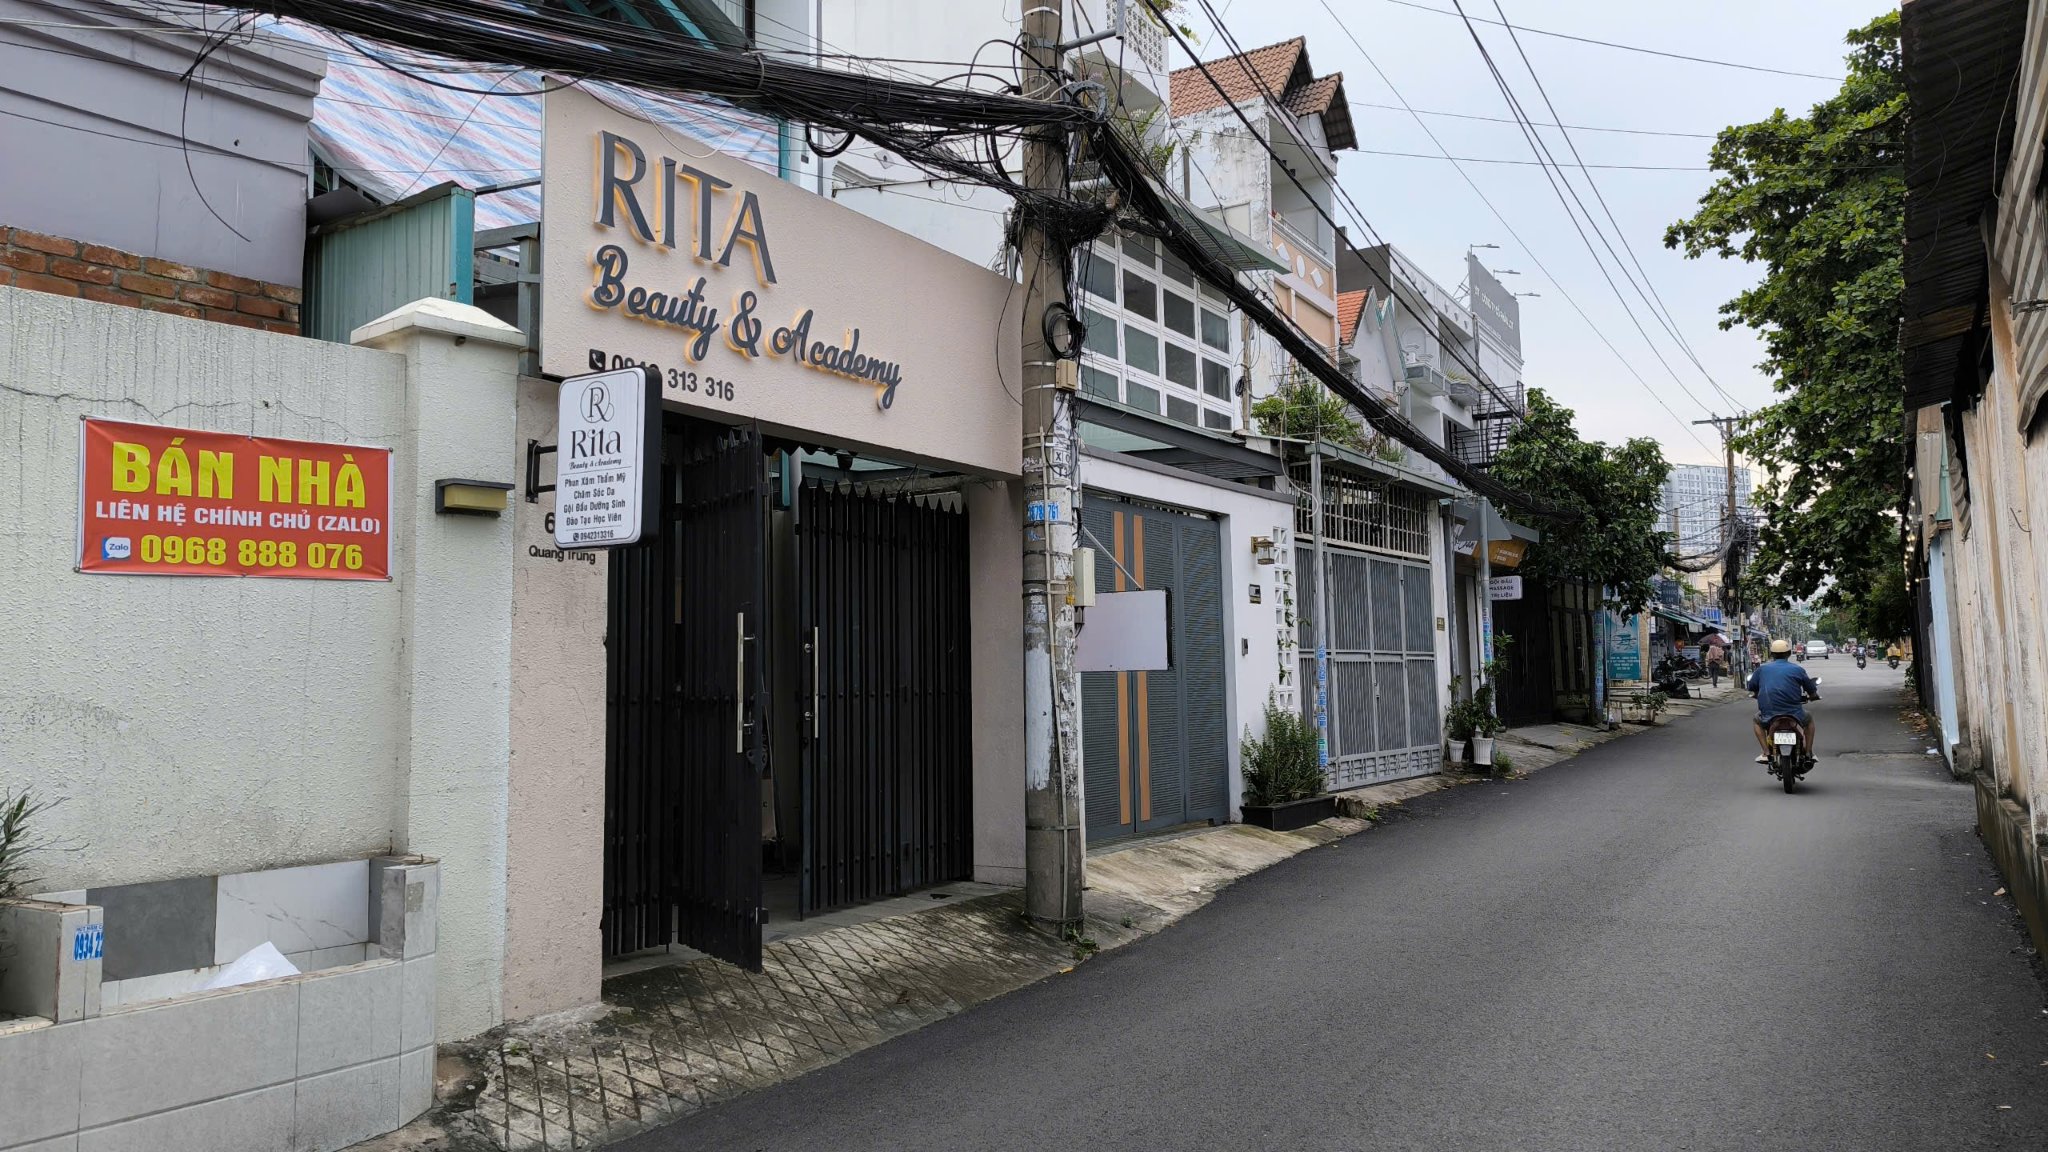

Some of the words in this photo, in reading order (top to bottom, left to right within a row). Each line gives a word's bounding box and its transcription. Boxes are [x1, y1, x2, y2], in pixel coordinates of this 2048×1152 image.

[594, 129, 777, 285] RITA
[593, 244, 720, 362] Beauty
[731, 290, 762, 358] &
[772, 309, 902, 411] Academy
[667, 368, 698, 393] 313
[705, 377, 734, 401] 316
[571, 428, 621, 459] Rita
[112, 437, 233, 500] BÁN
[259, 453, 366, 509] NHÀ
[565, 478, 579, 488] Phun
[593, 488, 604, 498] Sóc
[607, 487, 615, 496] Da
[612, 499, 626, 509] Sinh
[95, 500, 149, 521] LIÊN
[157, 504, 187, 527] HỆ
[194, 505, 262, 527] CHÍNH
[269, 509, 311, 530] CHỦ
[318, 517, 380, 534] (ZALO)
[594, 514, 605, 525] Học
[608, 512, 622, 522] Viên
[109, 543, 129, 551] Zalo
[140, 534, 227, 566] 0968
[238, 539, 297, 568] 888
[307, 542, 363, 570] 076
[529, 545, 564, 562] Quang
